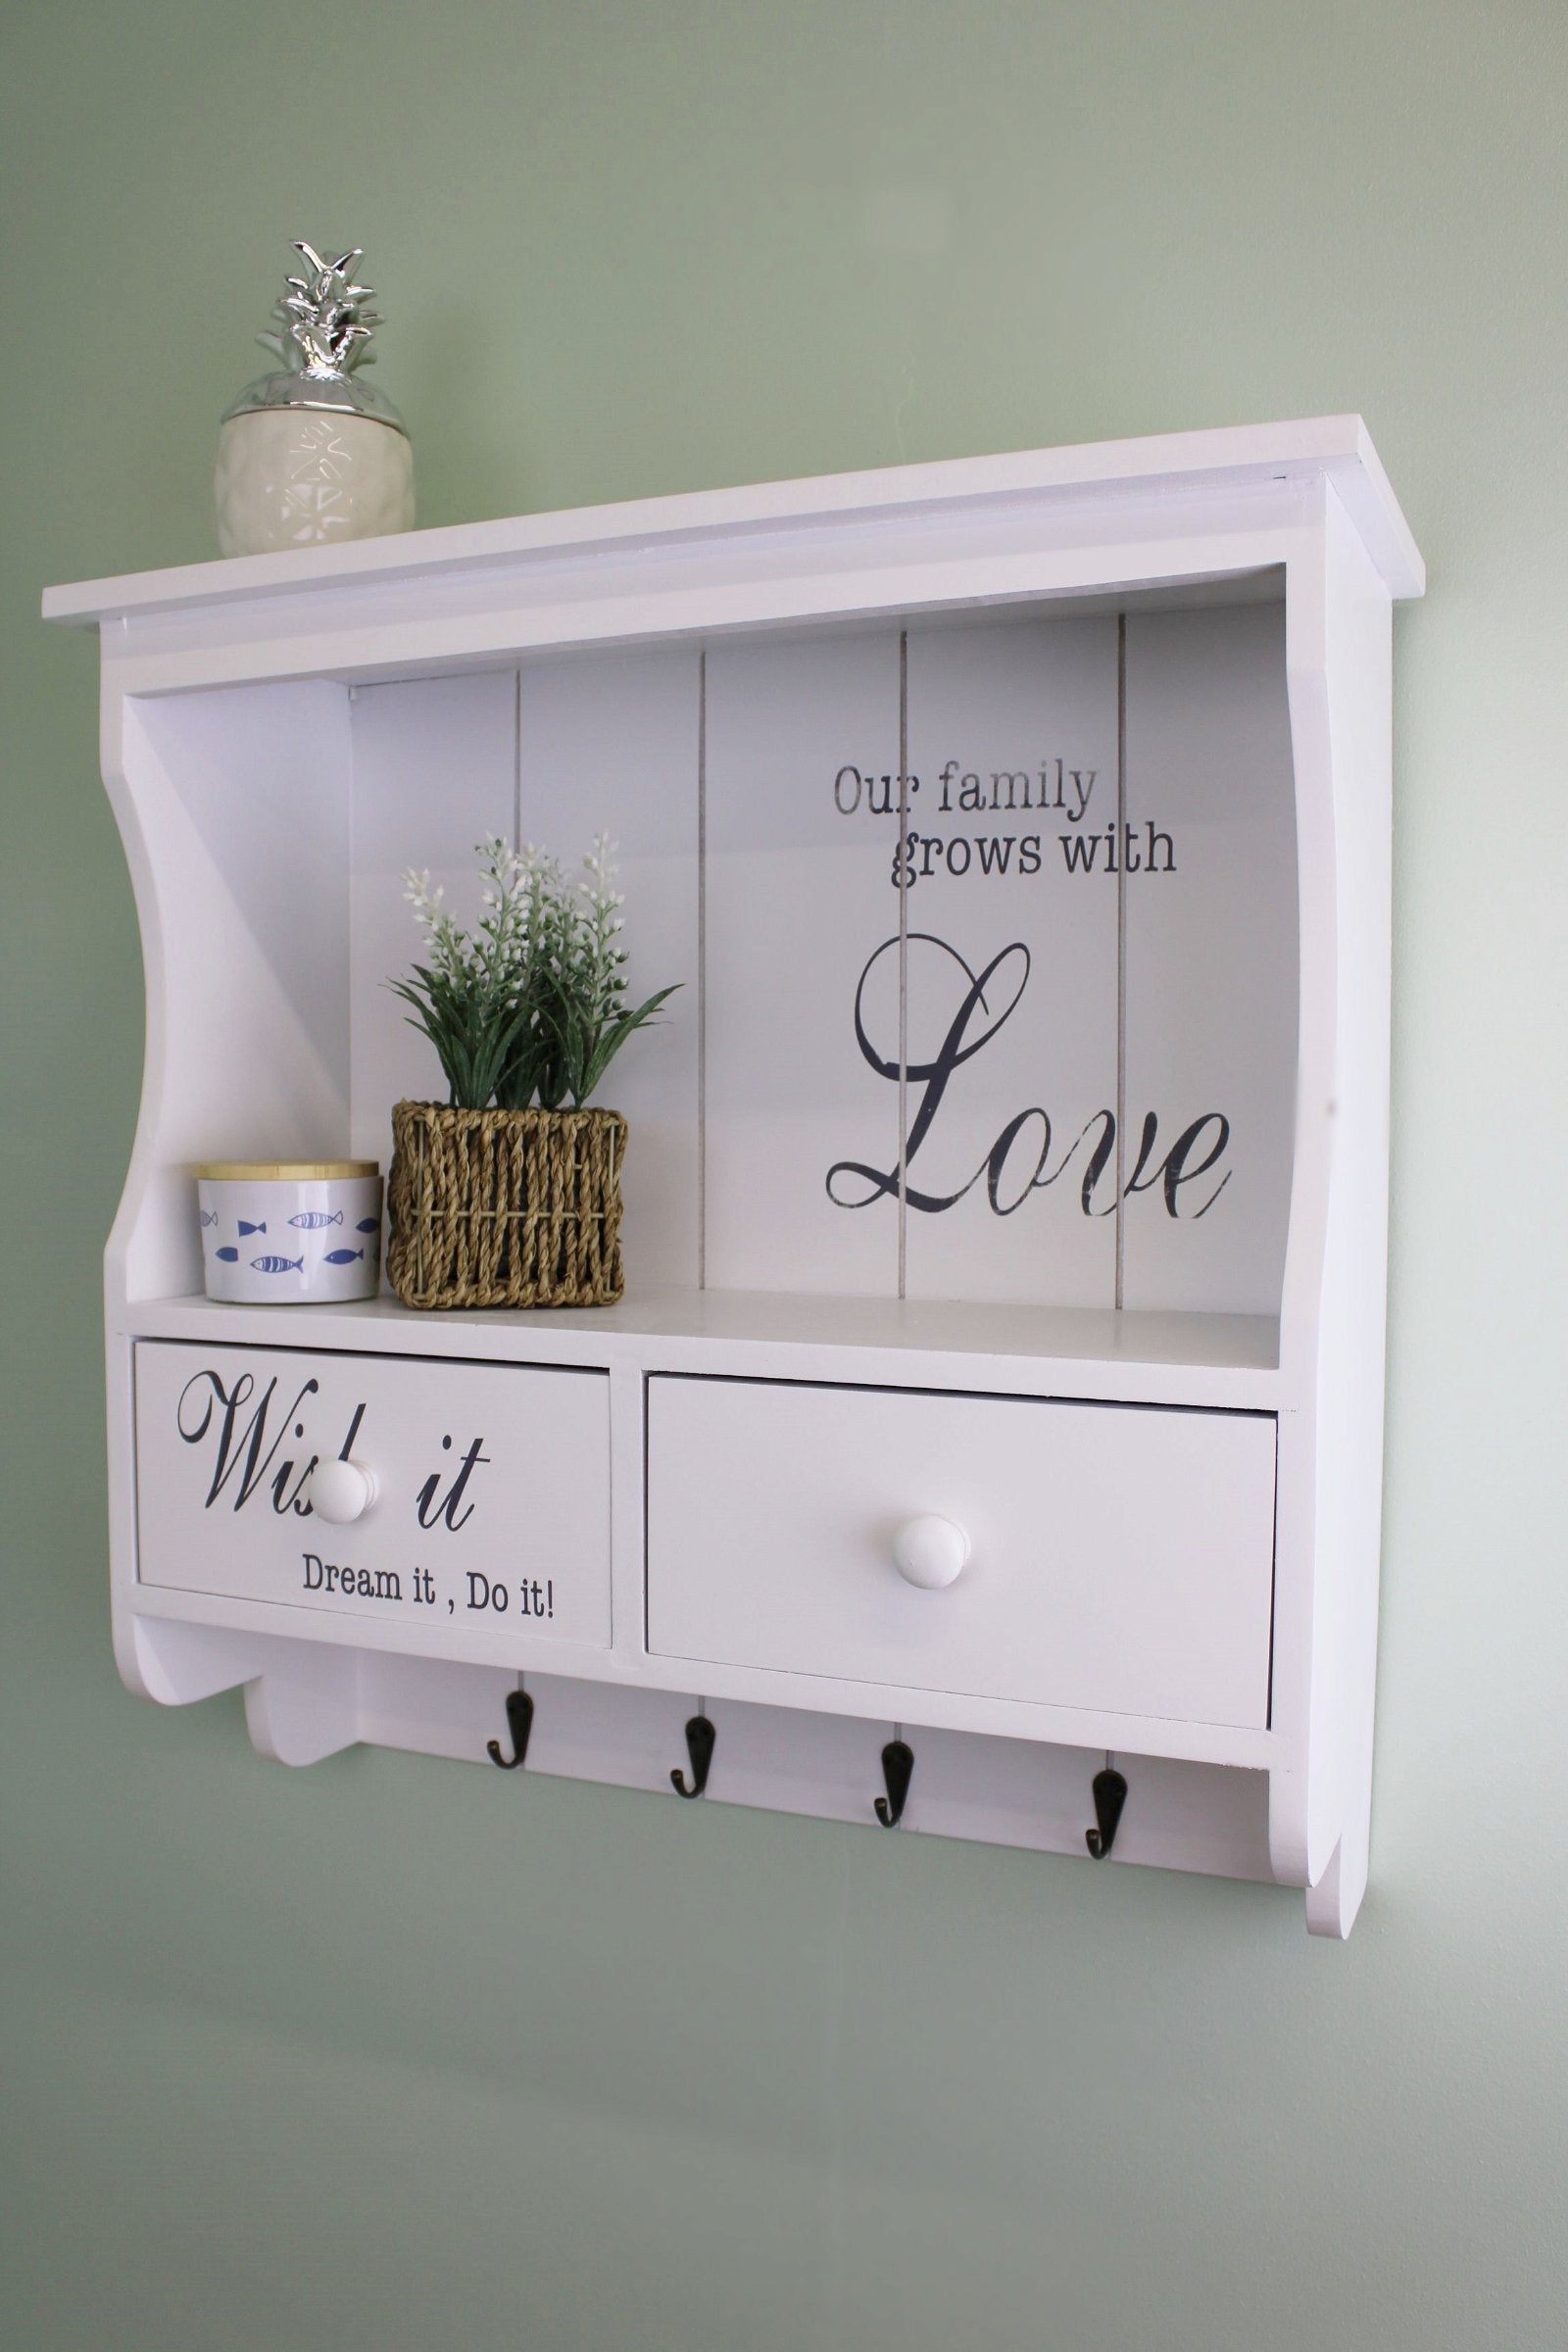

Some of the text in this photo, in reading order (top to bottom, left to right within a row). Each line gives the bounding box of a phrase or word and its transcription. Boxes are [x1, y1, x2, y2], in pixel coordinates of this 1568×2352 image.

[833, 760, 1100, 822] Our family
[891, 821, 1177, 888] grows with
[825, 932, 1232, 1219] Love
[416, 1434, 491, 1532] it
[302, 1553, 403, 1600] Dream
[466, 1571, 509, 1612] Do
[520, 1579, 555, 1618] it!
